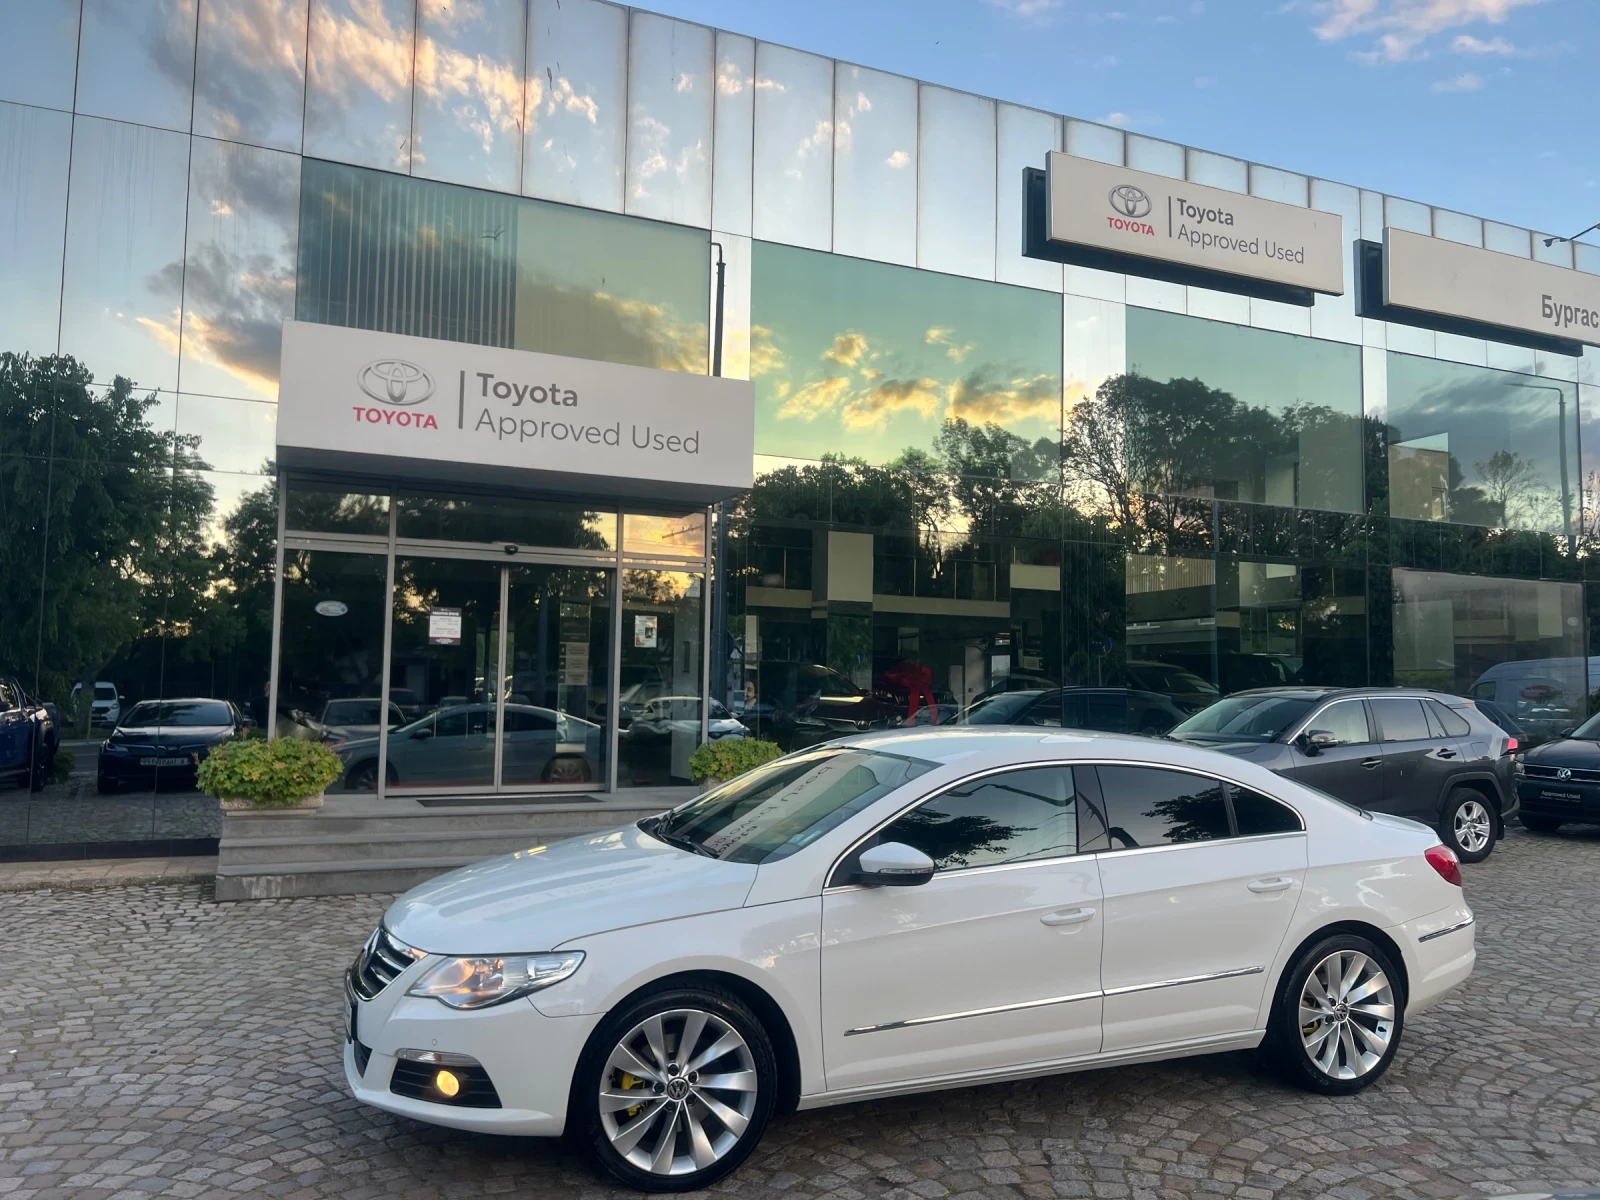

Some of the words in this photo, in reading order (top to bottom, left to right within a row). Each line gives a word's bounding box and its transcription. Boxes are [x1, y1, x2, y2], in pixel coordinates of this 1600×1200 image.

[1107, 217, 1155, 236] TOYOTA
[1177, 198, 1234, 226] Toyota
[1178, 224, 1259, 255] Approved
[1265, 240, 1304, 264] Used
[1542, 294, 1599, 328] Бургас
[476, 372, 578, 407] Toyota
[352, 407, 438, 430] TOYOTA
[475, 408, 620, 446] Approved
[632, 425, 699, 454] Used
[1541, 790, 1566, 798] Approved
